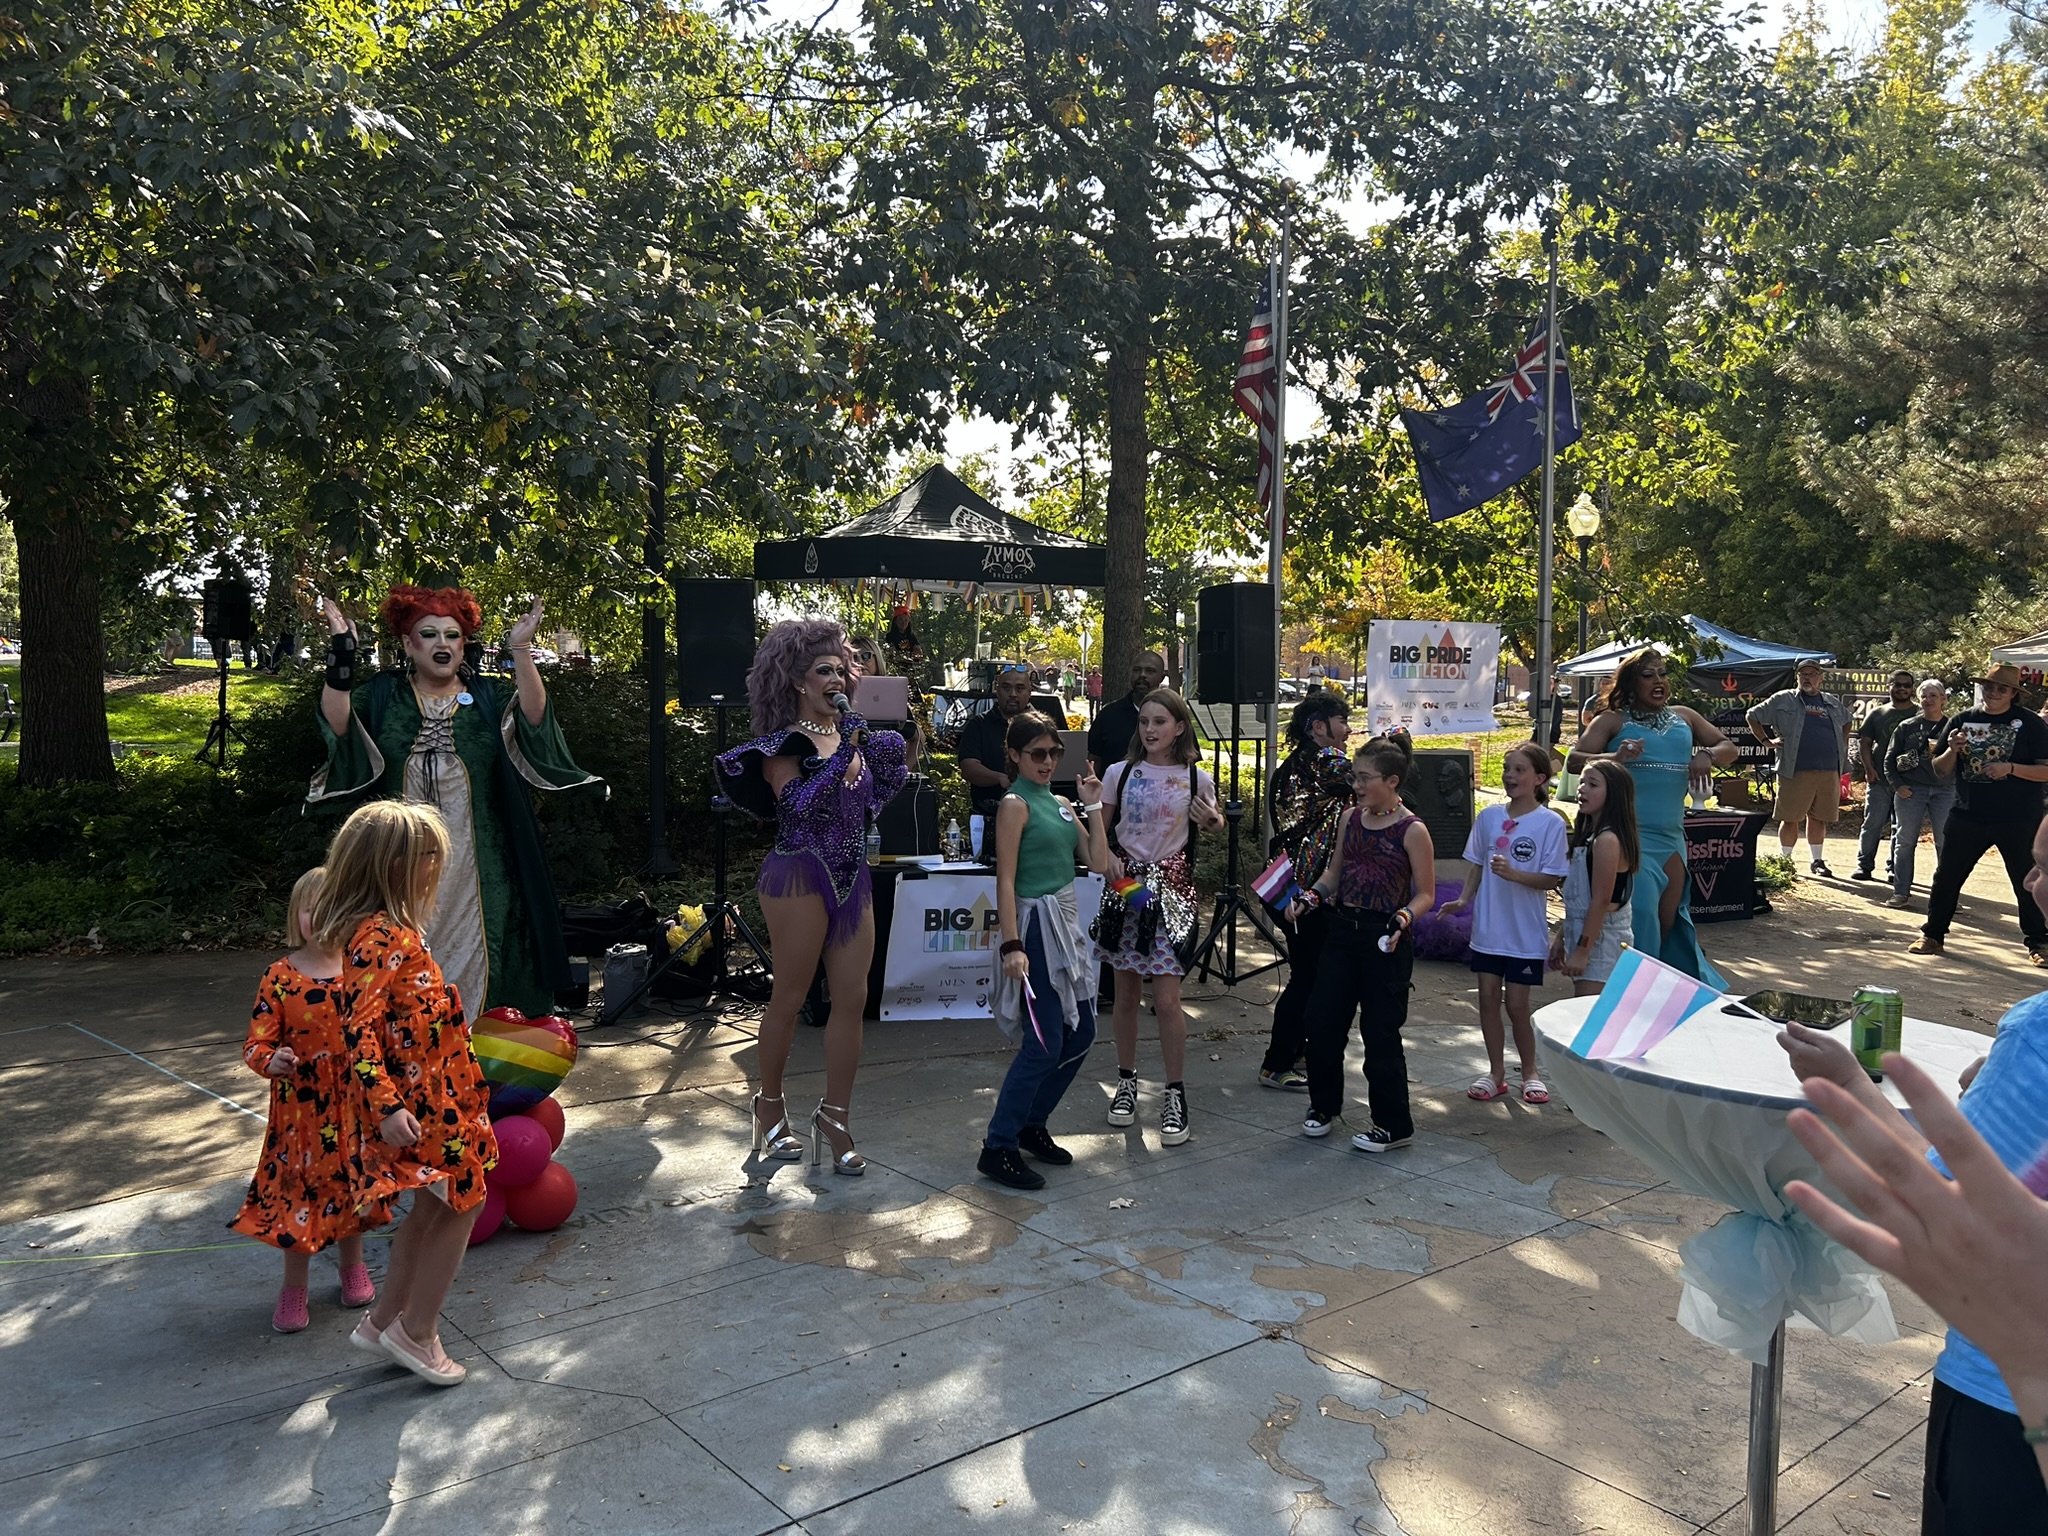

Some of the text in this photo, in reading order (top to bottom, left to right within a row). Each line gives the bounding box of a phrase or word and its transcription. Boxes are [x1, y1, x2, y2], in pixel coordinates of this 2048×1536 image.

[982, 545, 1035, 573] ZYMOS
[1390, 645, 1472, 664] BIG PRIDE
[1389, 662, 1471, 679] LITTLETON
[1849, 683, 1864, 691] THE
[1756, 746, 1769, 756] DAY
[1687, 839, 1744, 860] issFitts
[925, 908, 974, 931] BIG
